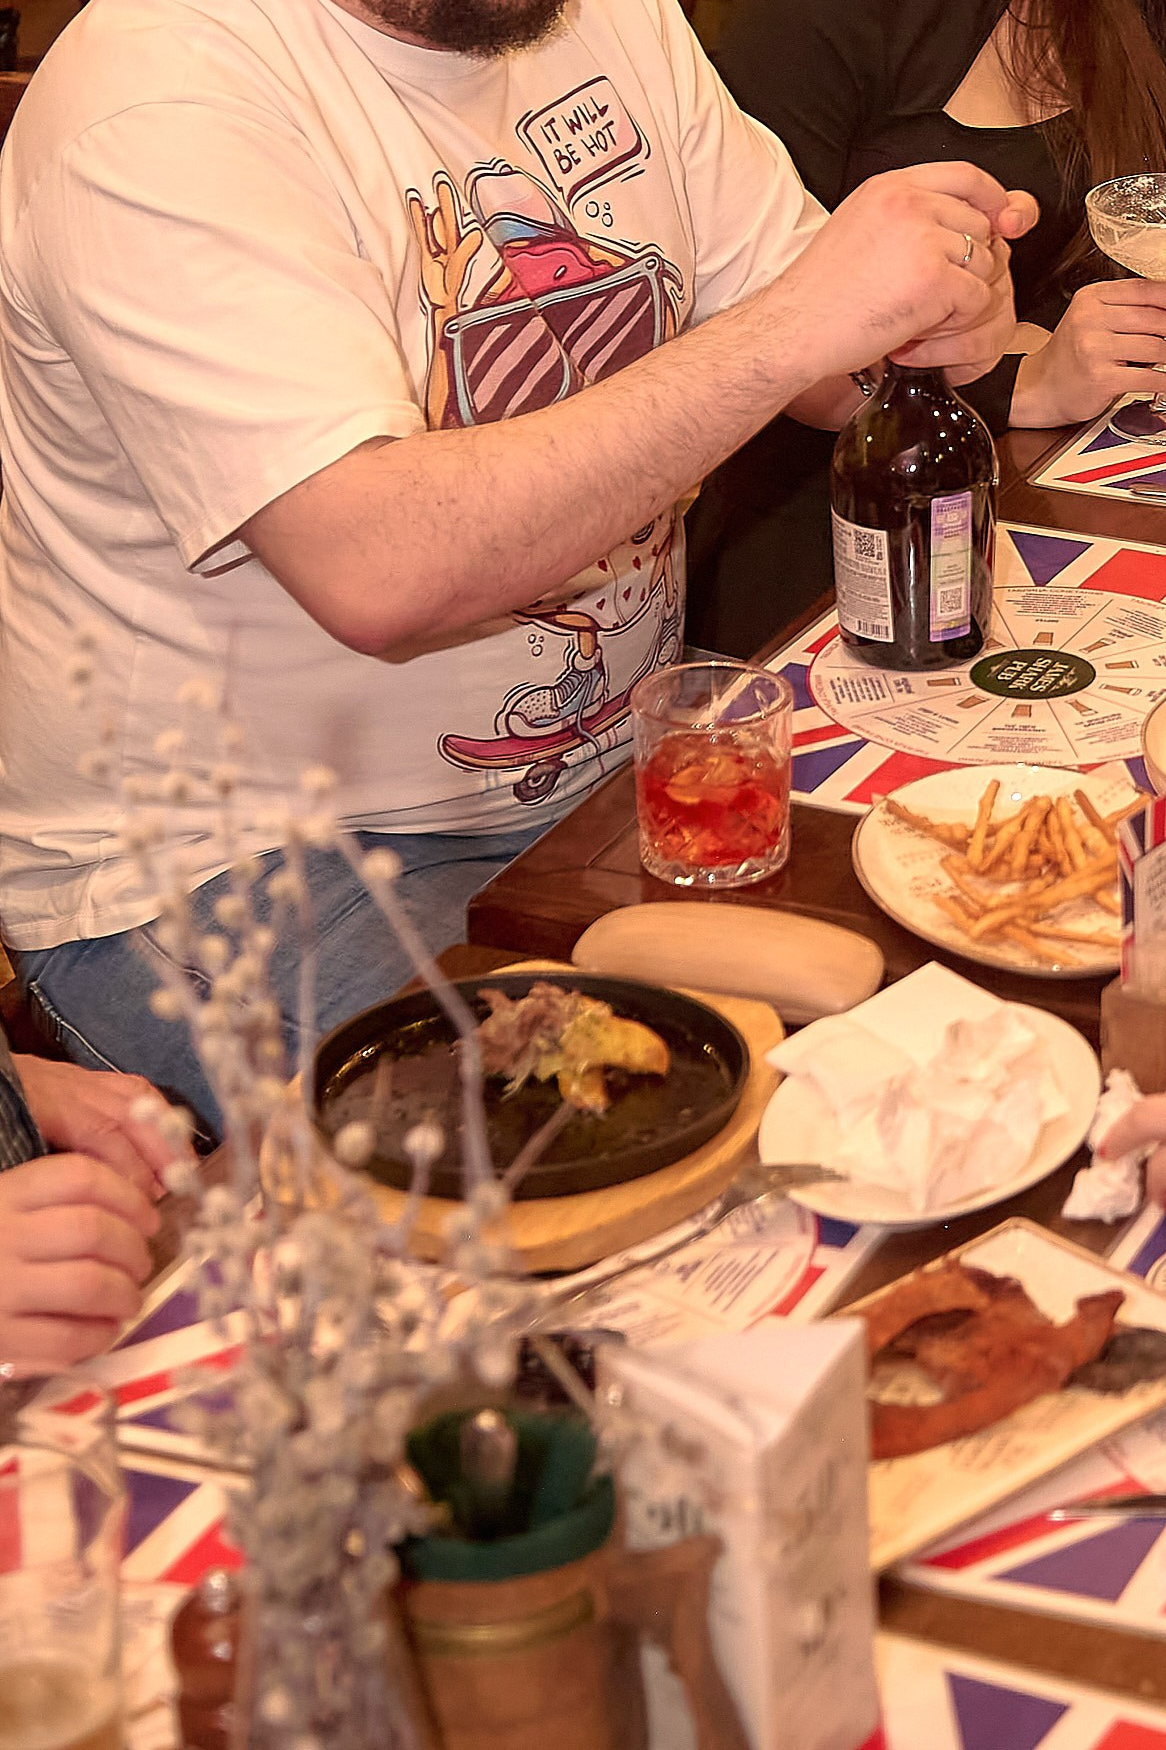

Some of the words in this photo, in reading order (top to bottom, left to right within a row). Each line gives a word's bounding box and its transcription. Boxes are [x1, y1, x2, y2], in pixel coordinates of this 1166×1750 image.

[539, 117, 562, 145] IT
[560, 95, 610, 136] WILL
[552, 142, 582, 175] BE
[580, 119, 617, 158] HOT
[997, 660, 1029, 681] PUB
[1008, 657, 1052, 689] SHARK
[1029, 661, 1069, 692] JAMES
